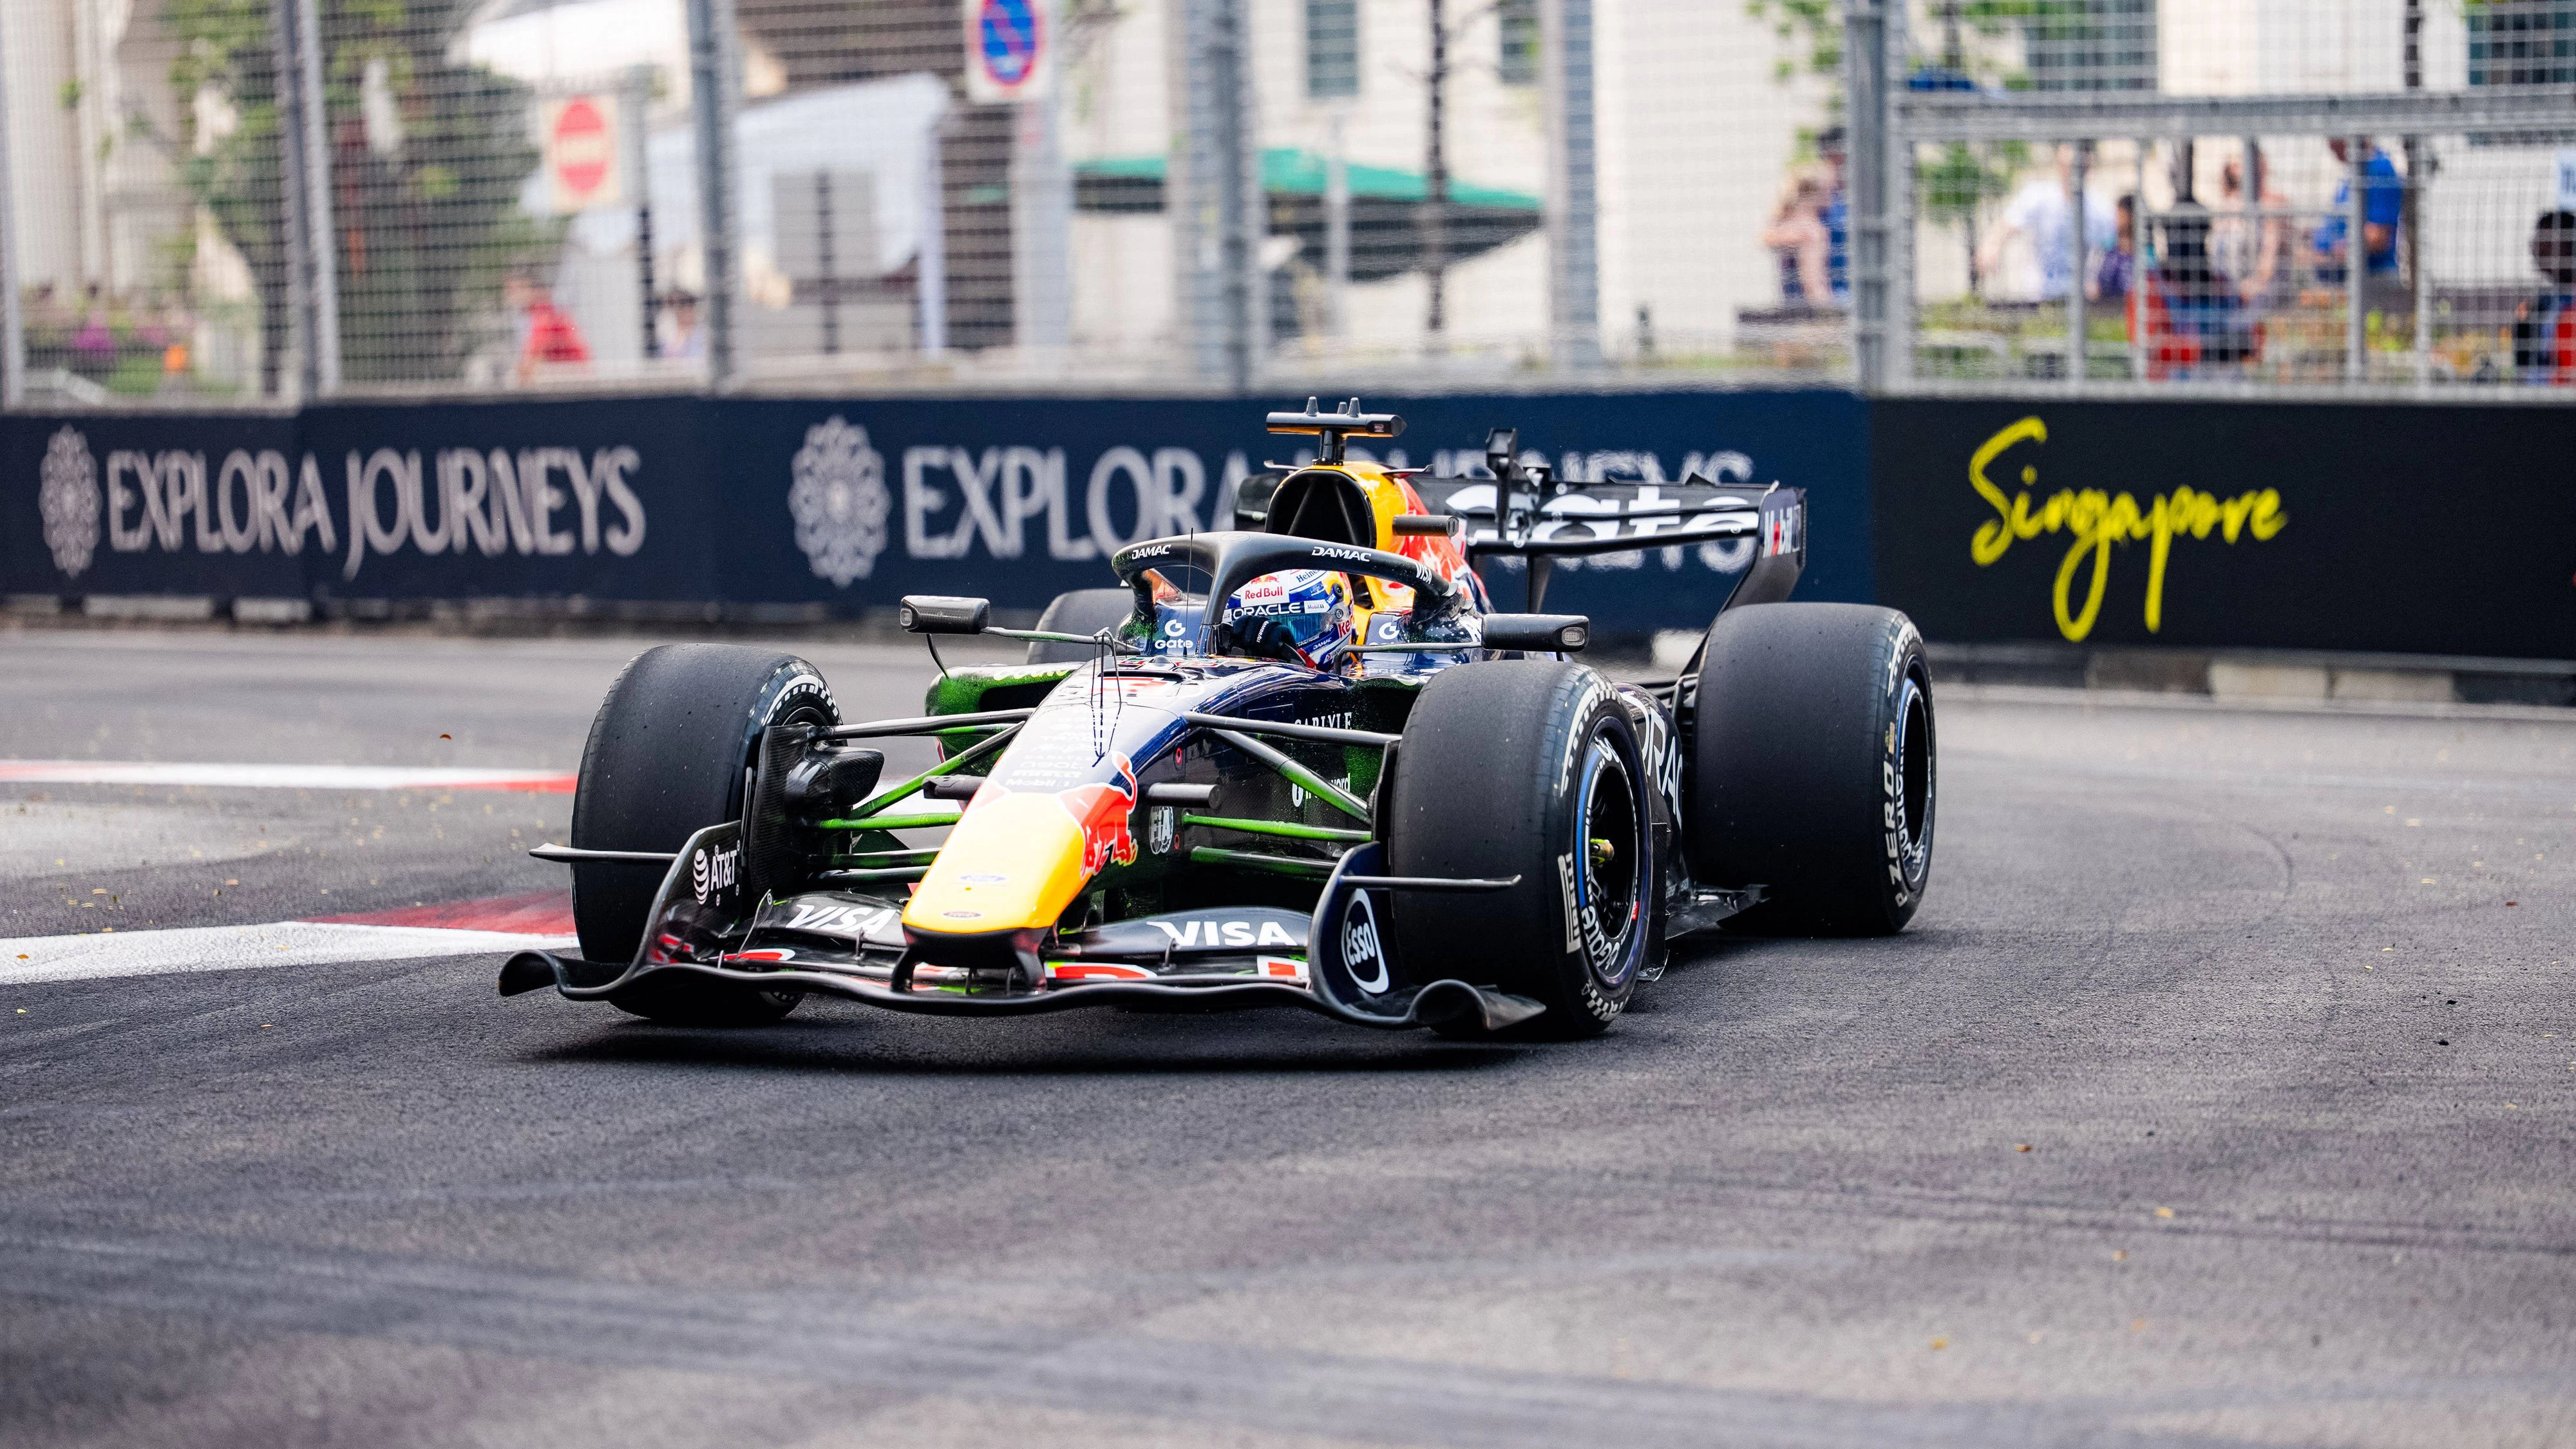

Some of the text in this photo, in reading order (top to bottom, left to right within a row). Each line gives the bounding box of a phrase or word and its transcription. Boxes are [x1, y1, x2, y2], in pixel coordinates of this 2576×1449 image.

[108, 444, 645, 582] EXPLORA JOURNEYS
[1968, 415, 2289, 642] Singapore
[1132, 544, 1171, 560] DAMAC
[1311, 546, 1372, 562] DAMAC
[1296, 570, 1320, 583] Heine
[1413, 561, 1432, 584] VISA
[1245, 586, 1283, 600] Red Bull
[1233, 601, 1302, 620] ORACLE
[1154, 638, 1194, 649] Gate
[1313, 637, 1332, 650] DAMAC
[1883, 760, 1902, 886] ZERO
[710, 849, 737, 891] AT&T
[1557, 851, 1581, 954] PIRELLI
[786, 904, 896, 934] VISA
[1146, 921, 1298, 947] VISA
